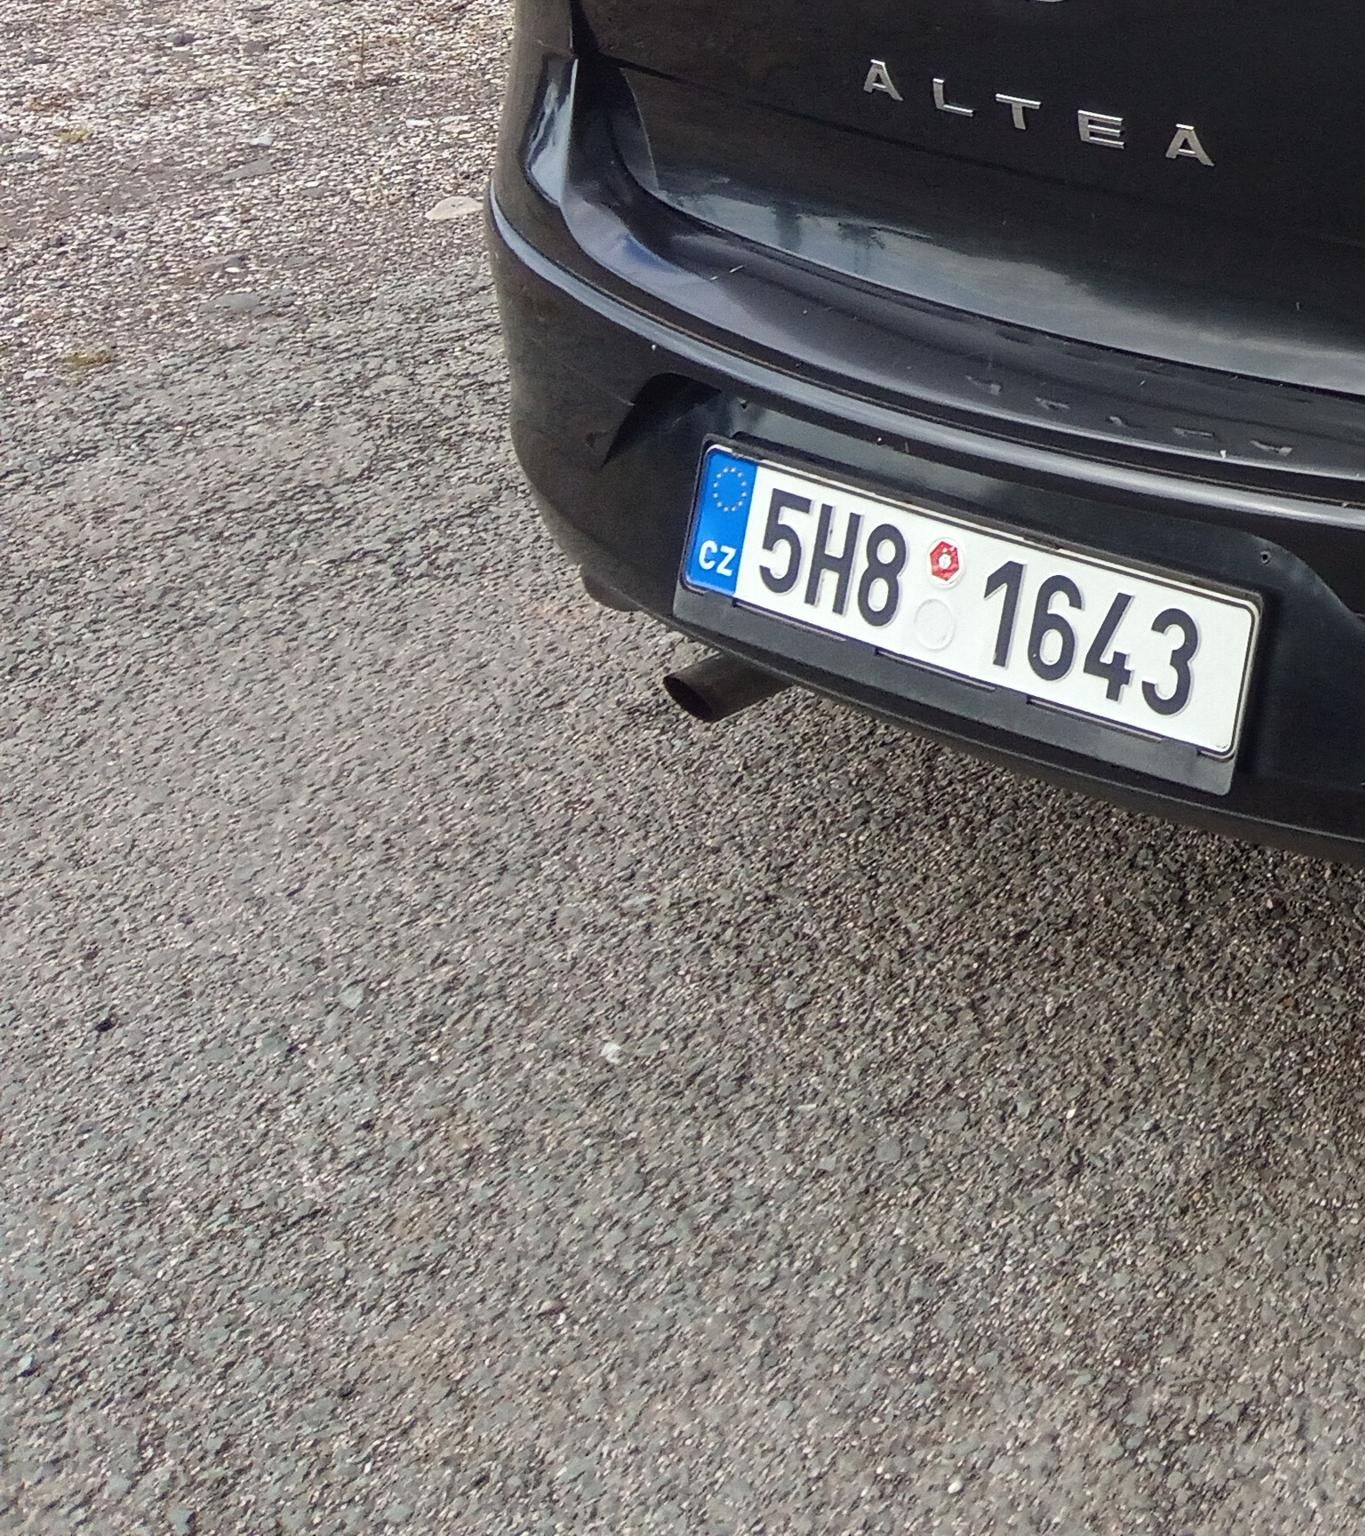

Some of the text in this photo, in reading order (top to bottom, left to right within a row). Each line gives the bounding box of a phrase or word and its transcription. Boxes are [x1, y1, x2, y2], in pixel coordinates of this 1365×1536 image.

[864, 59, 1215, 167] ALTEA
[698, 540, 737, 577] CZ
[759, 488, 1199, 715] 5H8 1643
